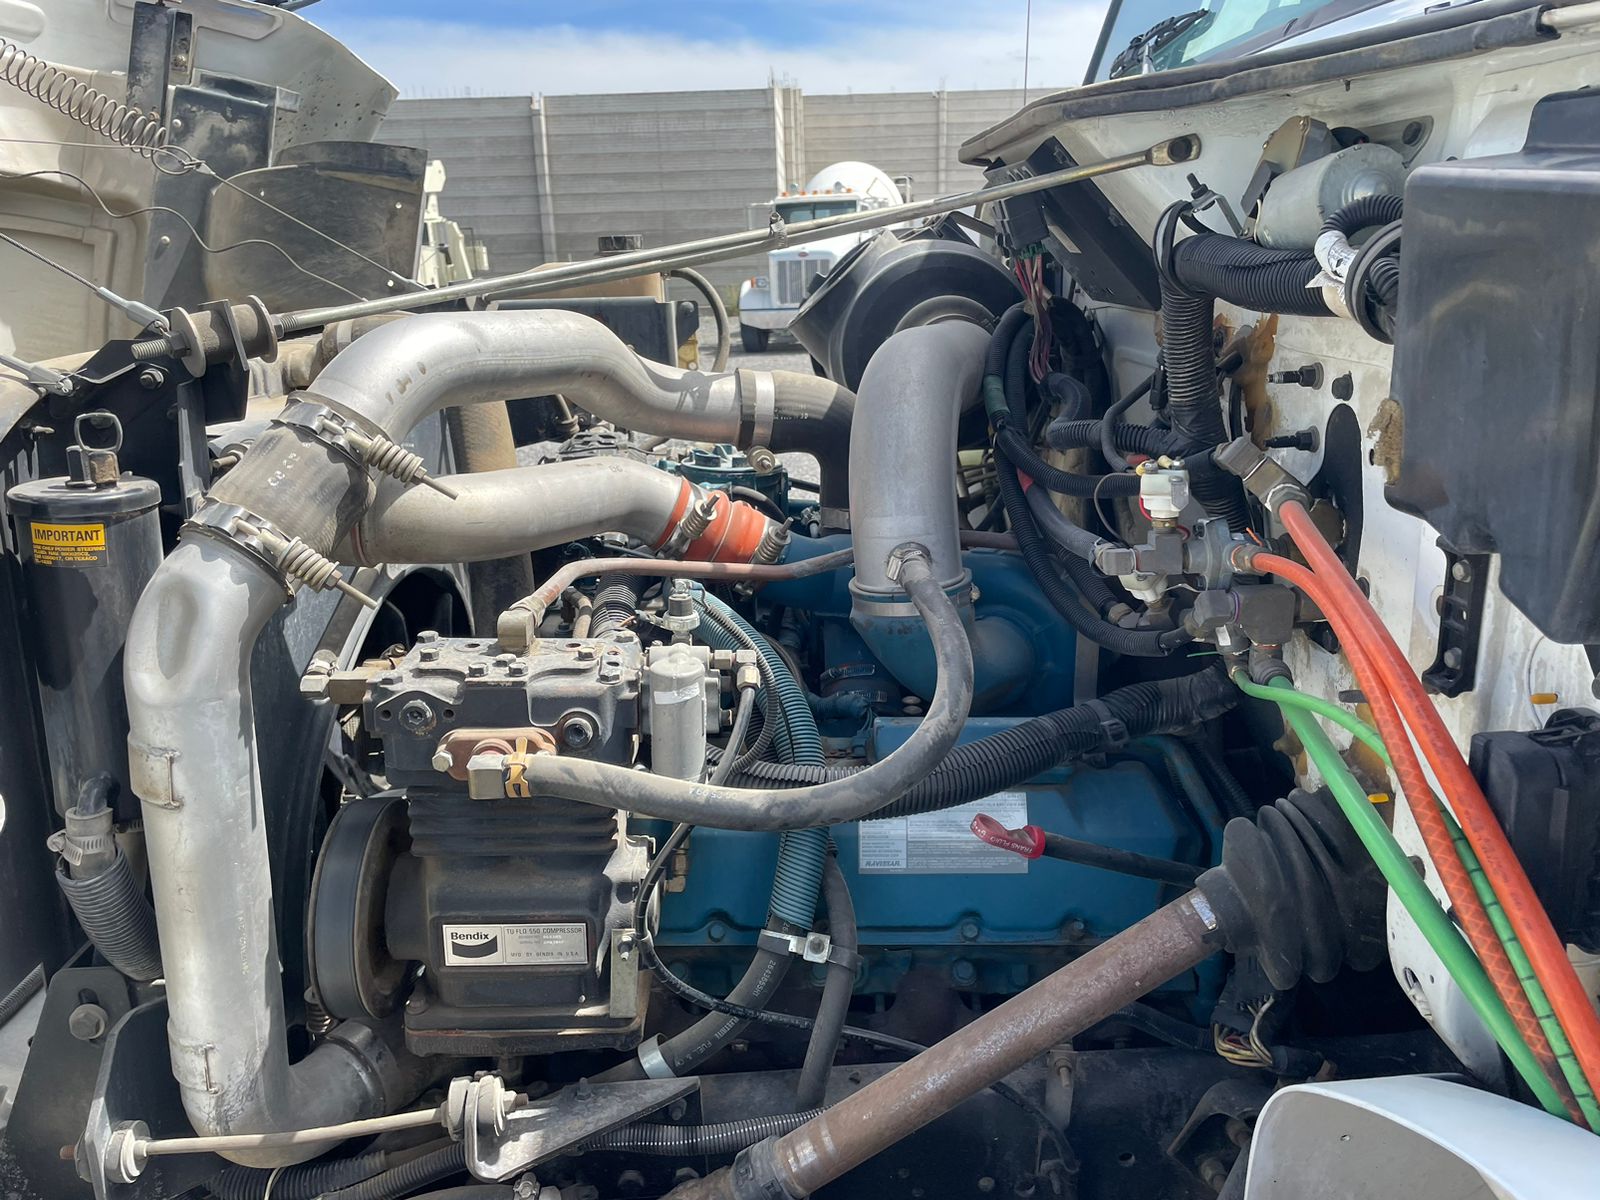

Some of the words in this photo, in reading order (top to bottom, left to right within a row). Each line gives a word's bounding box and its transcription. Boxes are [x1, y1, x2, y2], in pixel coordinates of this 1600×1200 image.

[34, 529, 101, 541] IMPORTANT
[990, 835, 1010, 847] FLUID
[1011, 841, 1033, 853] TRANS
[451, 932, 490, 940] Bendix
[693, 1040, 713, 1054] FUEL
